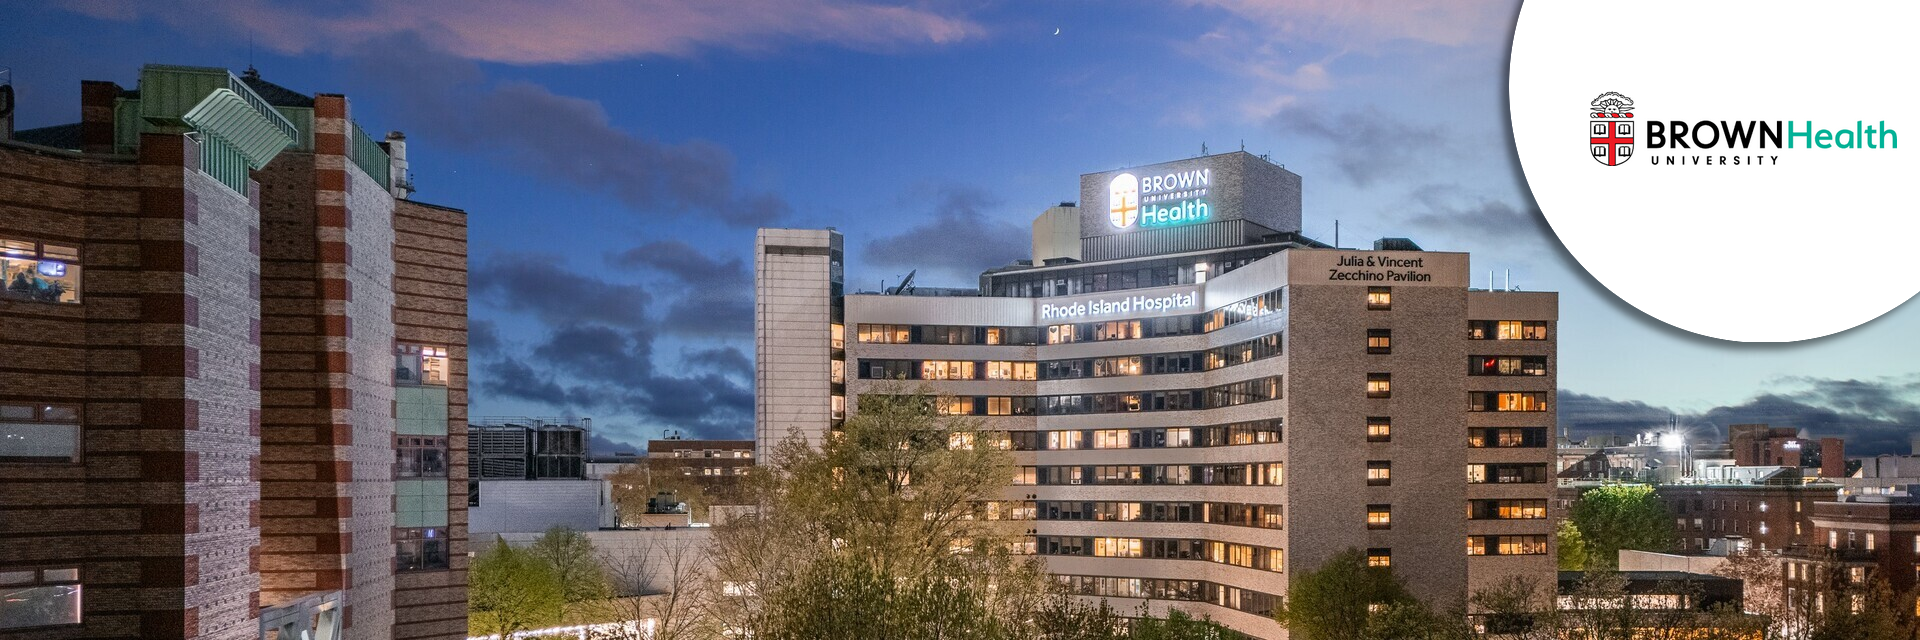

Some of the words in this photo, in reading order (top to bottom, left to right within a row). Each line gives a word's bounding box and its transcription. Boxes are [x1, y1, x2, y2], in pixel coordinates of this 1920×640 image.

[1142, 169, 1209, 193] BROWN
[1143, 188, 1208, 203] UNIVERSITY
[1141, 199, 1209, 225] Health
[1337, 256, 1364, 267] Julia
[1366, 256, 1375, 267] &
[1377, 256, 1423, 268] Vincent
[1329, 269, 1384, 282] Zecchino
[1387, 270, 1431, 282] Pavilion
[1042, 300, 1086, 319] Rhode
[1088, 295, 1130, 315] Island
[1133, 291, 1196, 312] Hospital
